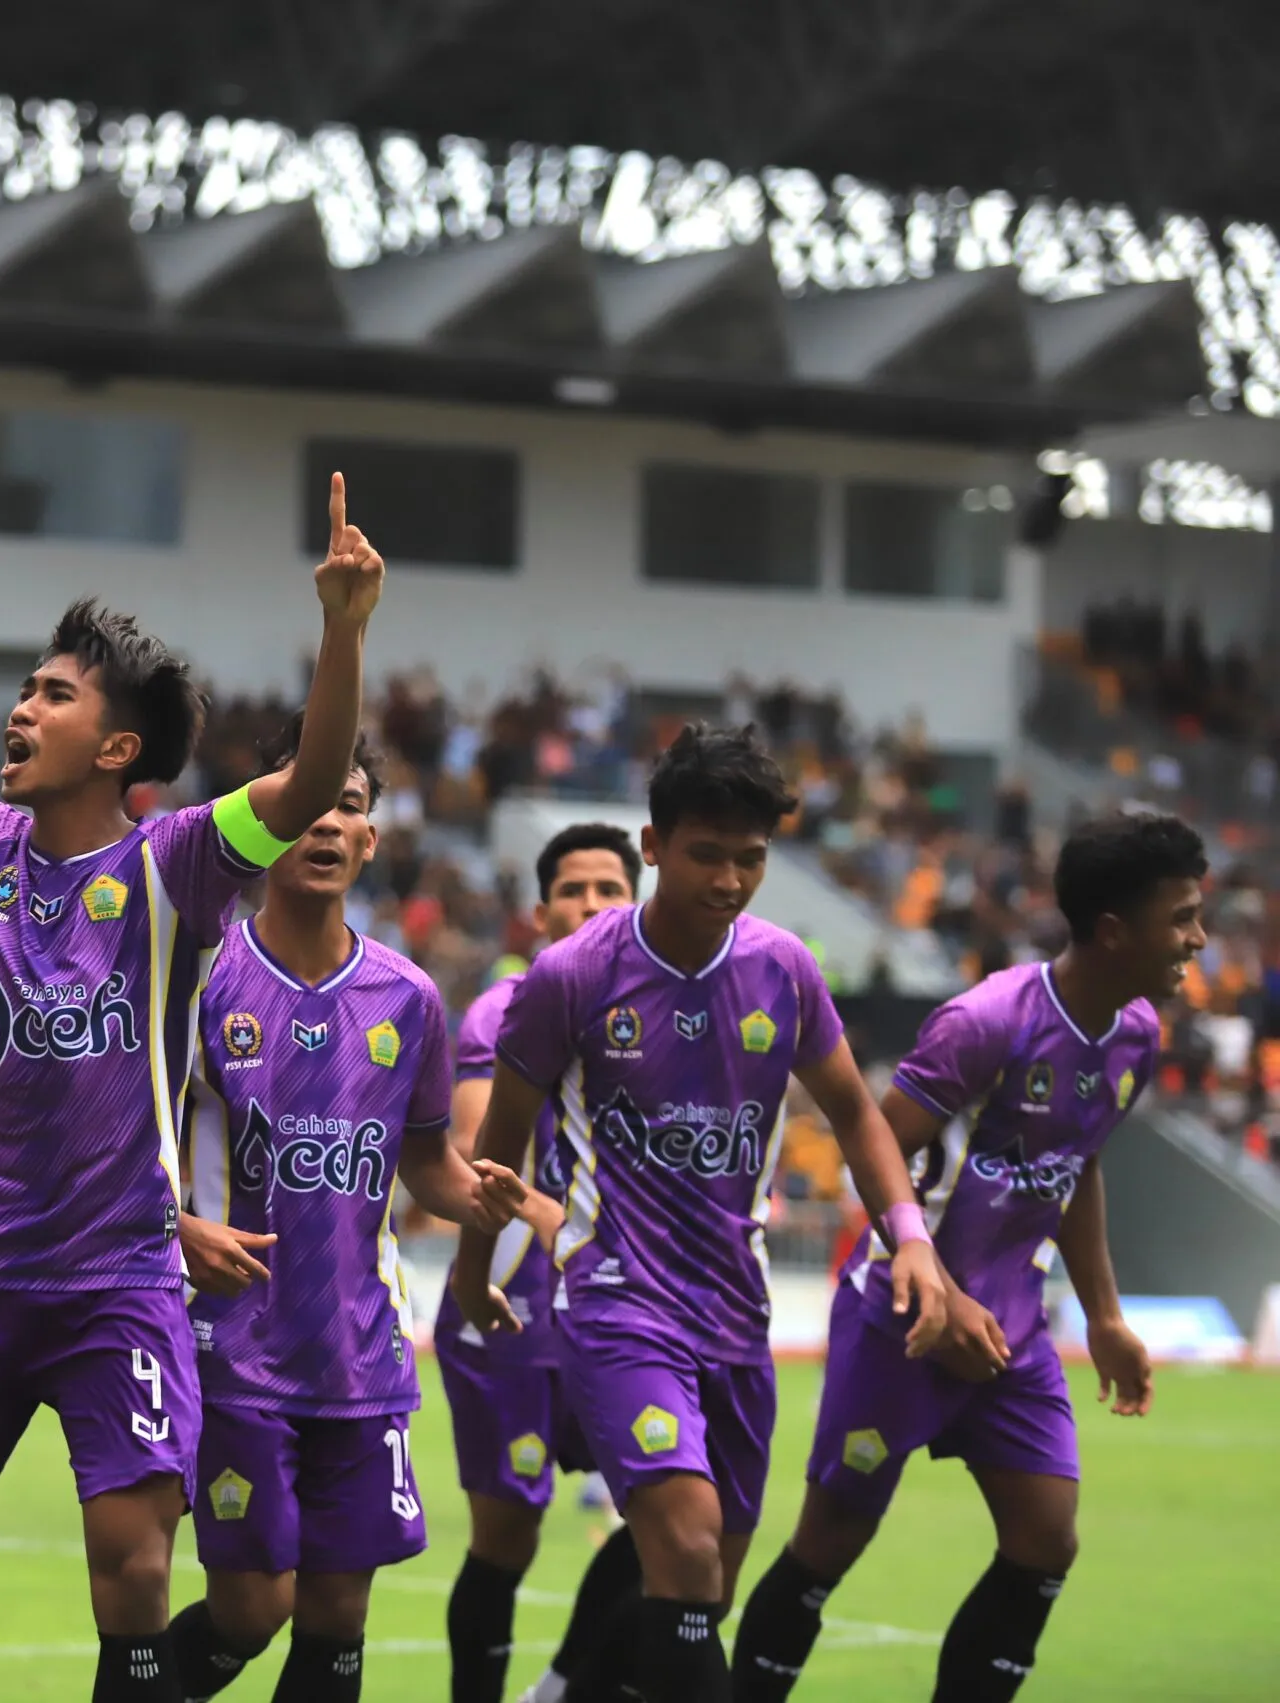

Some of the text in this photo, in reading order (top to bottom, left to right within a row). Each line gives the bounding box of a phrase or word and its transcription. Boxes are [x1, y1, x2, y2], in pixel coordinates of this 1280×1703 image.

[243, 1058, 263, 1069] ACEH
[235, 1097, 386, 1214] Aceh
[131, 1348, 162, 1410] 4
